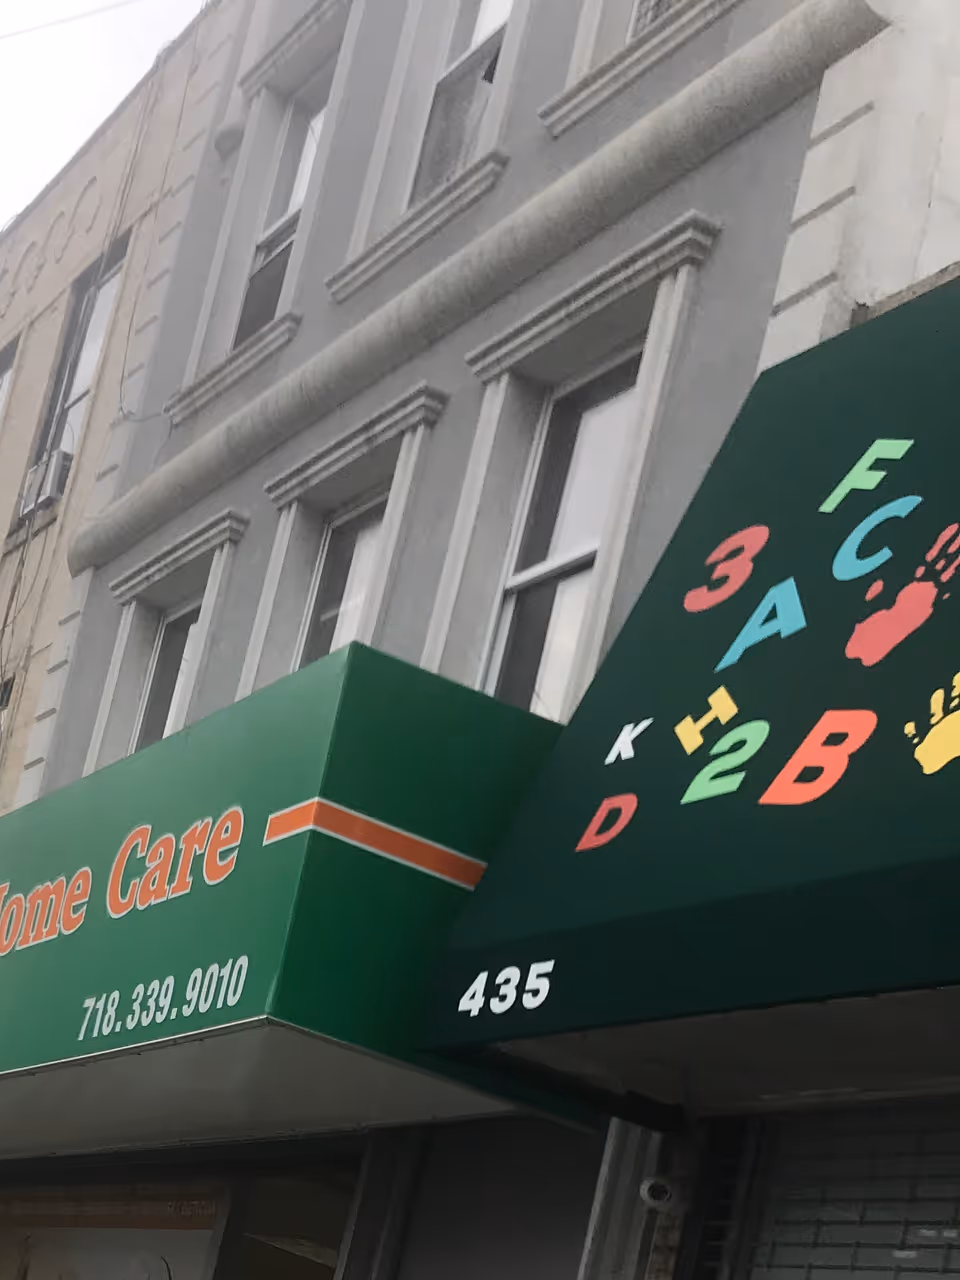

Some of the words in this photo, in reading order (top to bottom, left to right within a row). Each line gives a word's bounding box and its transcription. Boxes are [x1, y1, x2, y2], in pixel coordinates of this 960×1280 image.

[818, 438, 915, 514] F
[683, 524, 770, 613] 3
[832, 495, 924, 581] C
[714, 576, 807, 673] A
[604, 717, 655, 766] K
[680, 719, 771, 805] 2
[757, 709, 878, 806] B
[106, 805, 245, 919] Care
[575, 792, 638, 852] D
[77, 954, 249, 1041] 718.339.9010
[458, 959, 555, 1018] 435
